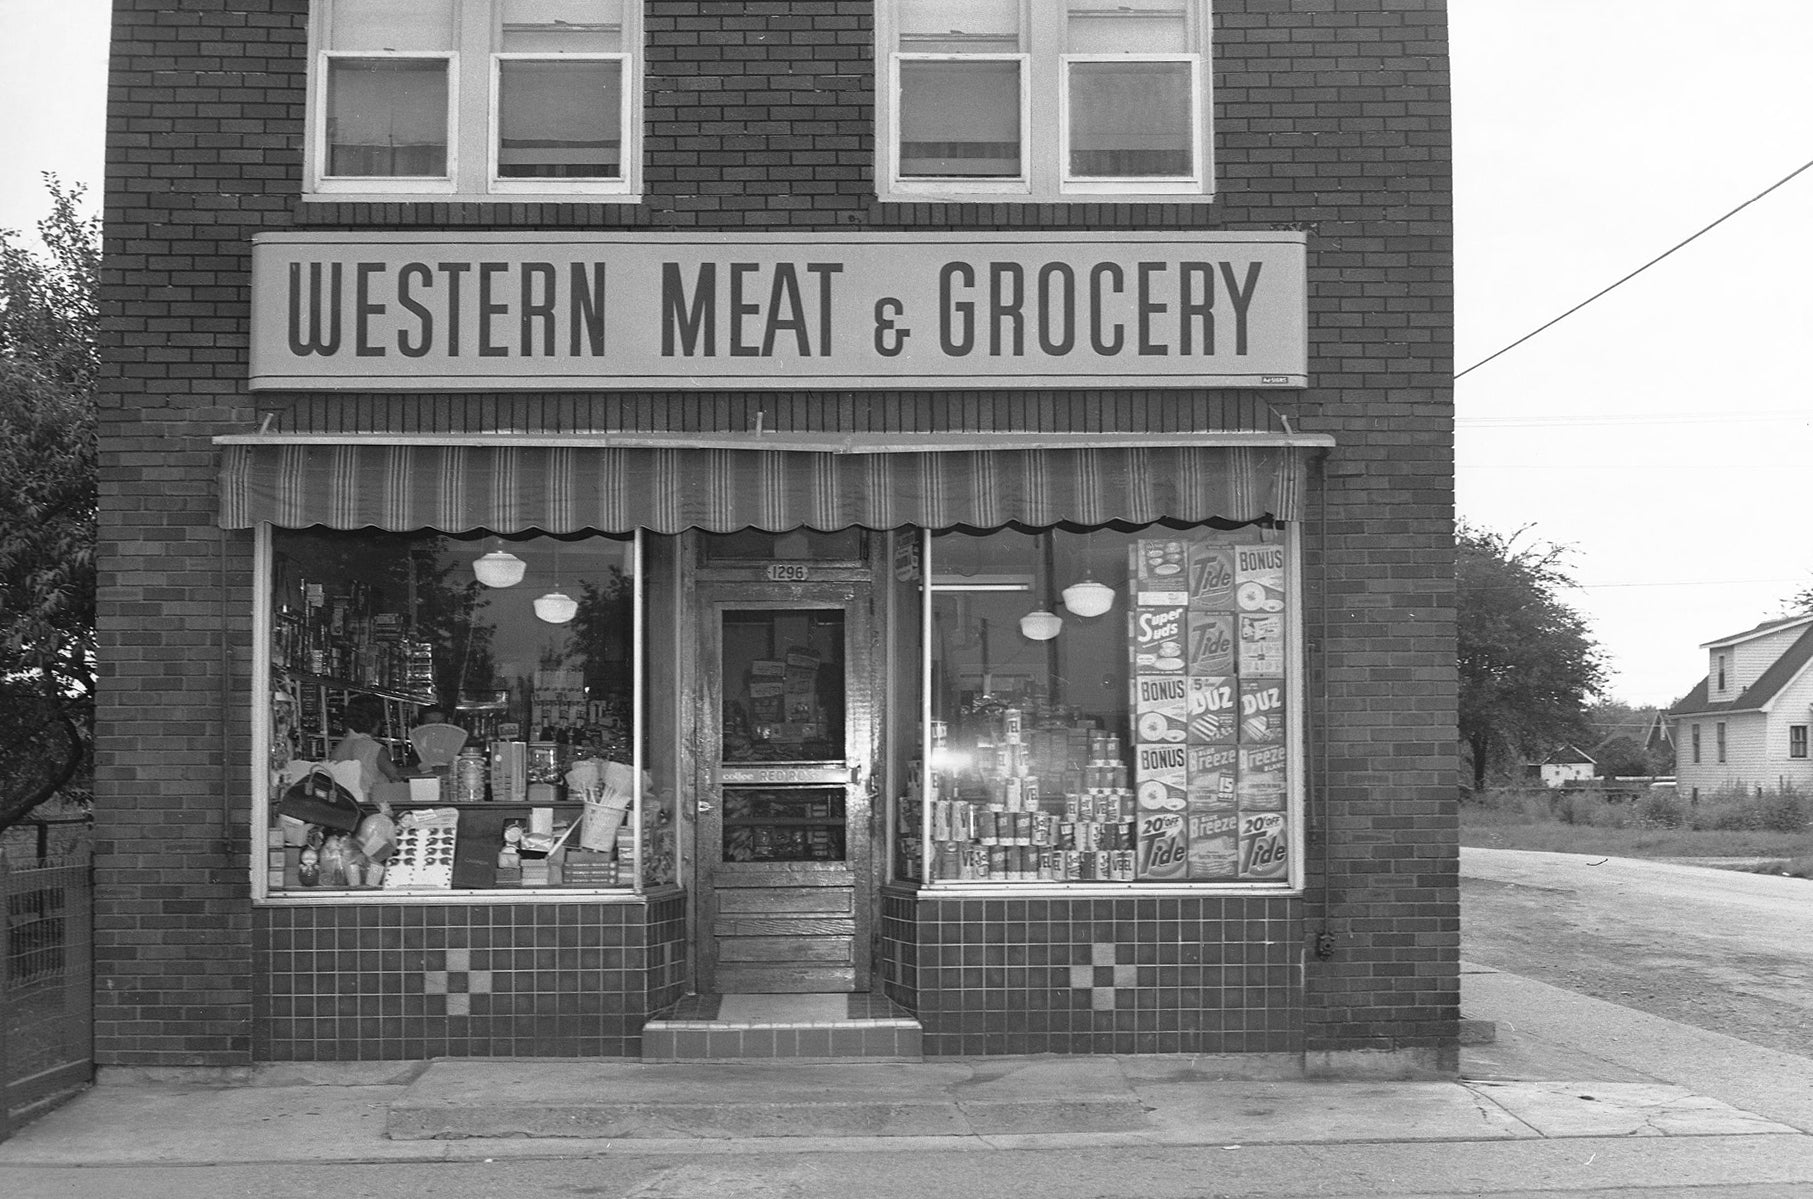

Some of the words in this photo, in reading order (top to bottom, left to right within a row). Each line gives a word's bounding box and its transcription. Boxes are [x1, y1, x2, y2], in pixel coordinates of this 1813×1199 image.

[288, 262, 606, 358] WESTERN
[661, 262, 844, 357] MEAT
[874, 297, 911, 357] &
[938, 261, 1263, 357] GROCERY
[772, 565, 804, 579] 1296
[1240, 550, 1283, 572] BONUS
[1192, 556, 1231, 598] Tide
[1138, 608, 1183, 642] Super
[1191, 622, 1230, 664] Tide
[1141, 680, 1185, 702] BONUS
[1190, 686, 1234, 715] DUZ
[1241, 687, 1281, 715] DUZ
[1142, 748, 1185, 770] BONUS
[1188, 750, 1236, 771] Breeze
[1240, 747, 1286, 771] Breeze
[1189, 816, 1236, 839] Breeze
[1140, 830, 1185, 875] Tide
[1240, 830, 1286, 875] Tide
